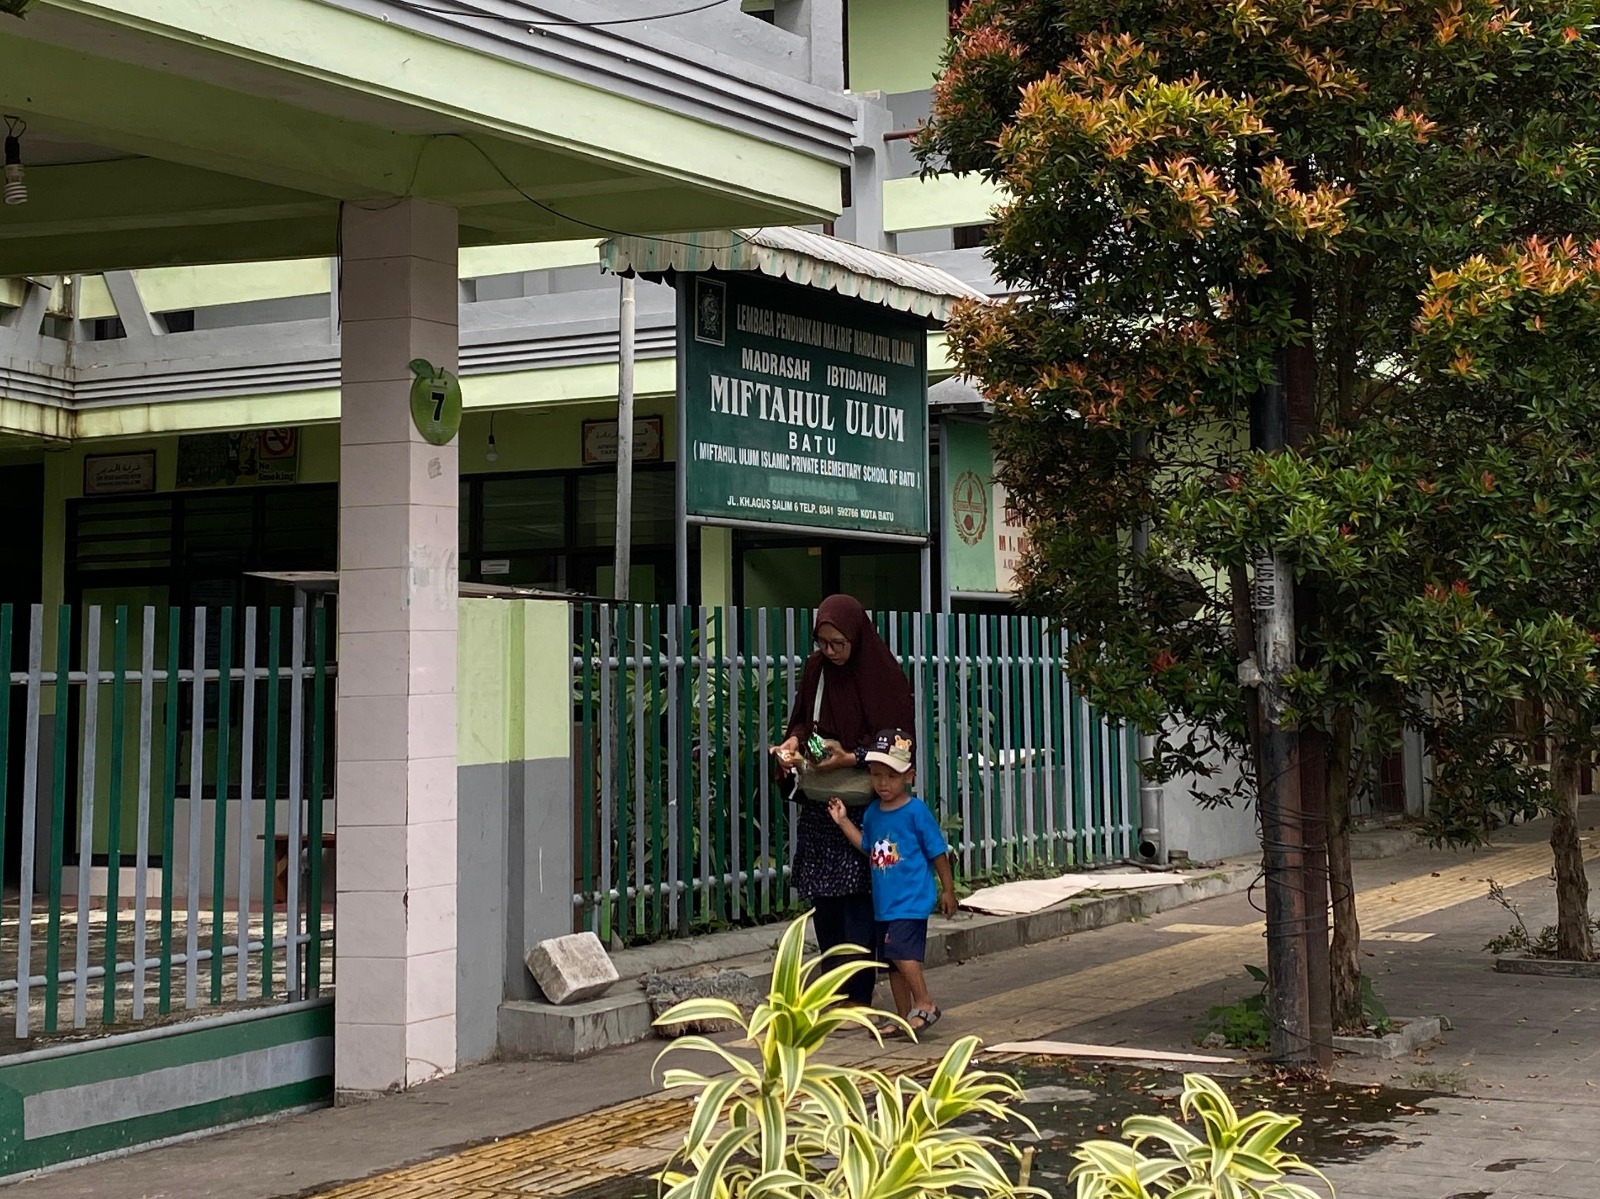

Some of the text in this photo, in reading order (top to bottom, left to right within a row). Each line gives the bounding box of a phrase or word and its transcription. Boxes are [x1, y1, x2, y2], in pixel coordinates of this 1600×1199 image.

[737, 304, 774, 337] LEMBAGA
[776, 312, 822, 347] PENDIDIKAN
[892, 338, 915, 367] ULAMA
[741, 347, 887, 396] MADRASAH IBTIDAIYAH
[431, 391, 445, 421] 7
[710, 374, 905, 443] MIFTAHUL ULUM
[789, 431, 836, 456] BATU
[257, 471, 294, 482] Smoking
[258, 461, 270, 471] No
[700, 442, 737, 464] MIFTAHUL
[739, 448, 760, 467] ULUM
[761, 450, 790, 471] ISLAMIC
[791, 455, 819, 475] PRIVATE
[820, 459, 861, 480] ELEMENTARY
[863, 465, 888, 484] SCHOOL
[889, 469, 898, 485] OF
[899, 470, 915, 487] BATU
[772, 499, 793, 511] SALIM
[794, 502, 799, 512] 6
[800, 502, 818, 514] TELP.
[819, 505, 833, 515] 0341
[860, 509, 877, 520] KOTA
[878, 511, 894, 522] BATU
[1257, 585, 1275, 606] 0822
